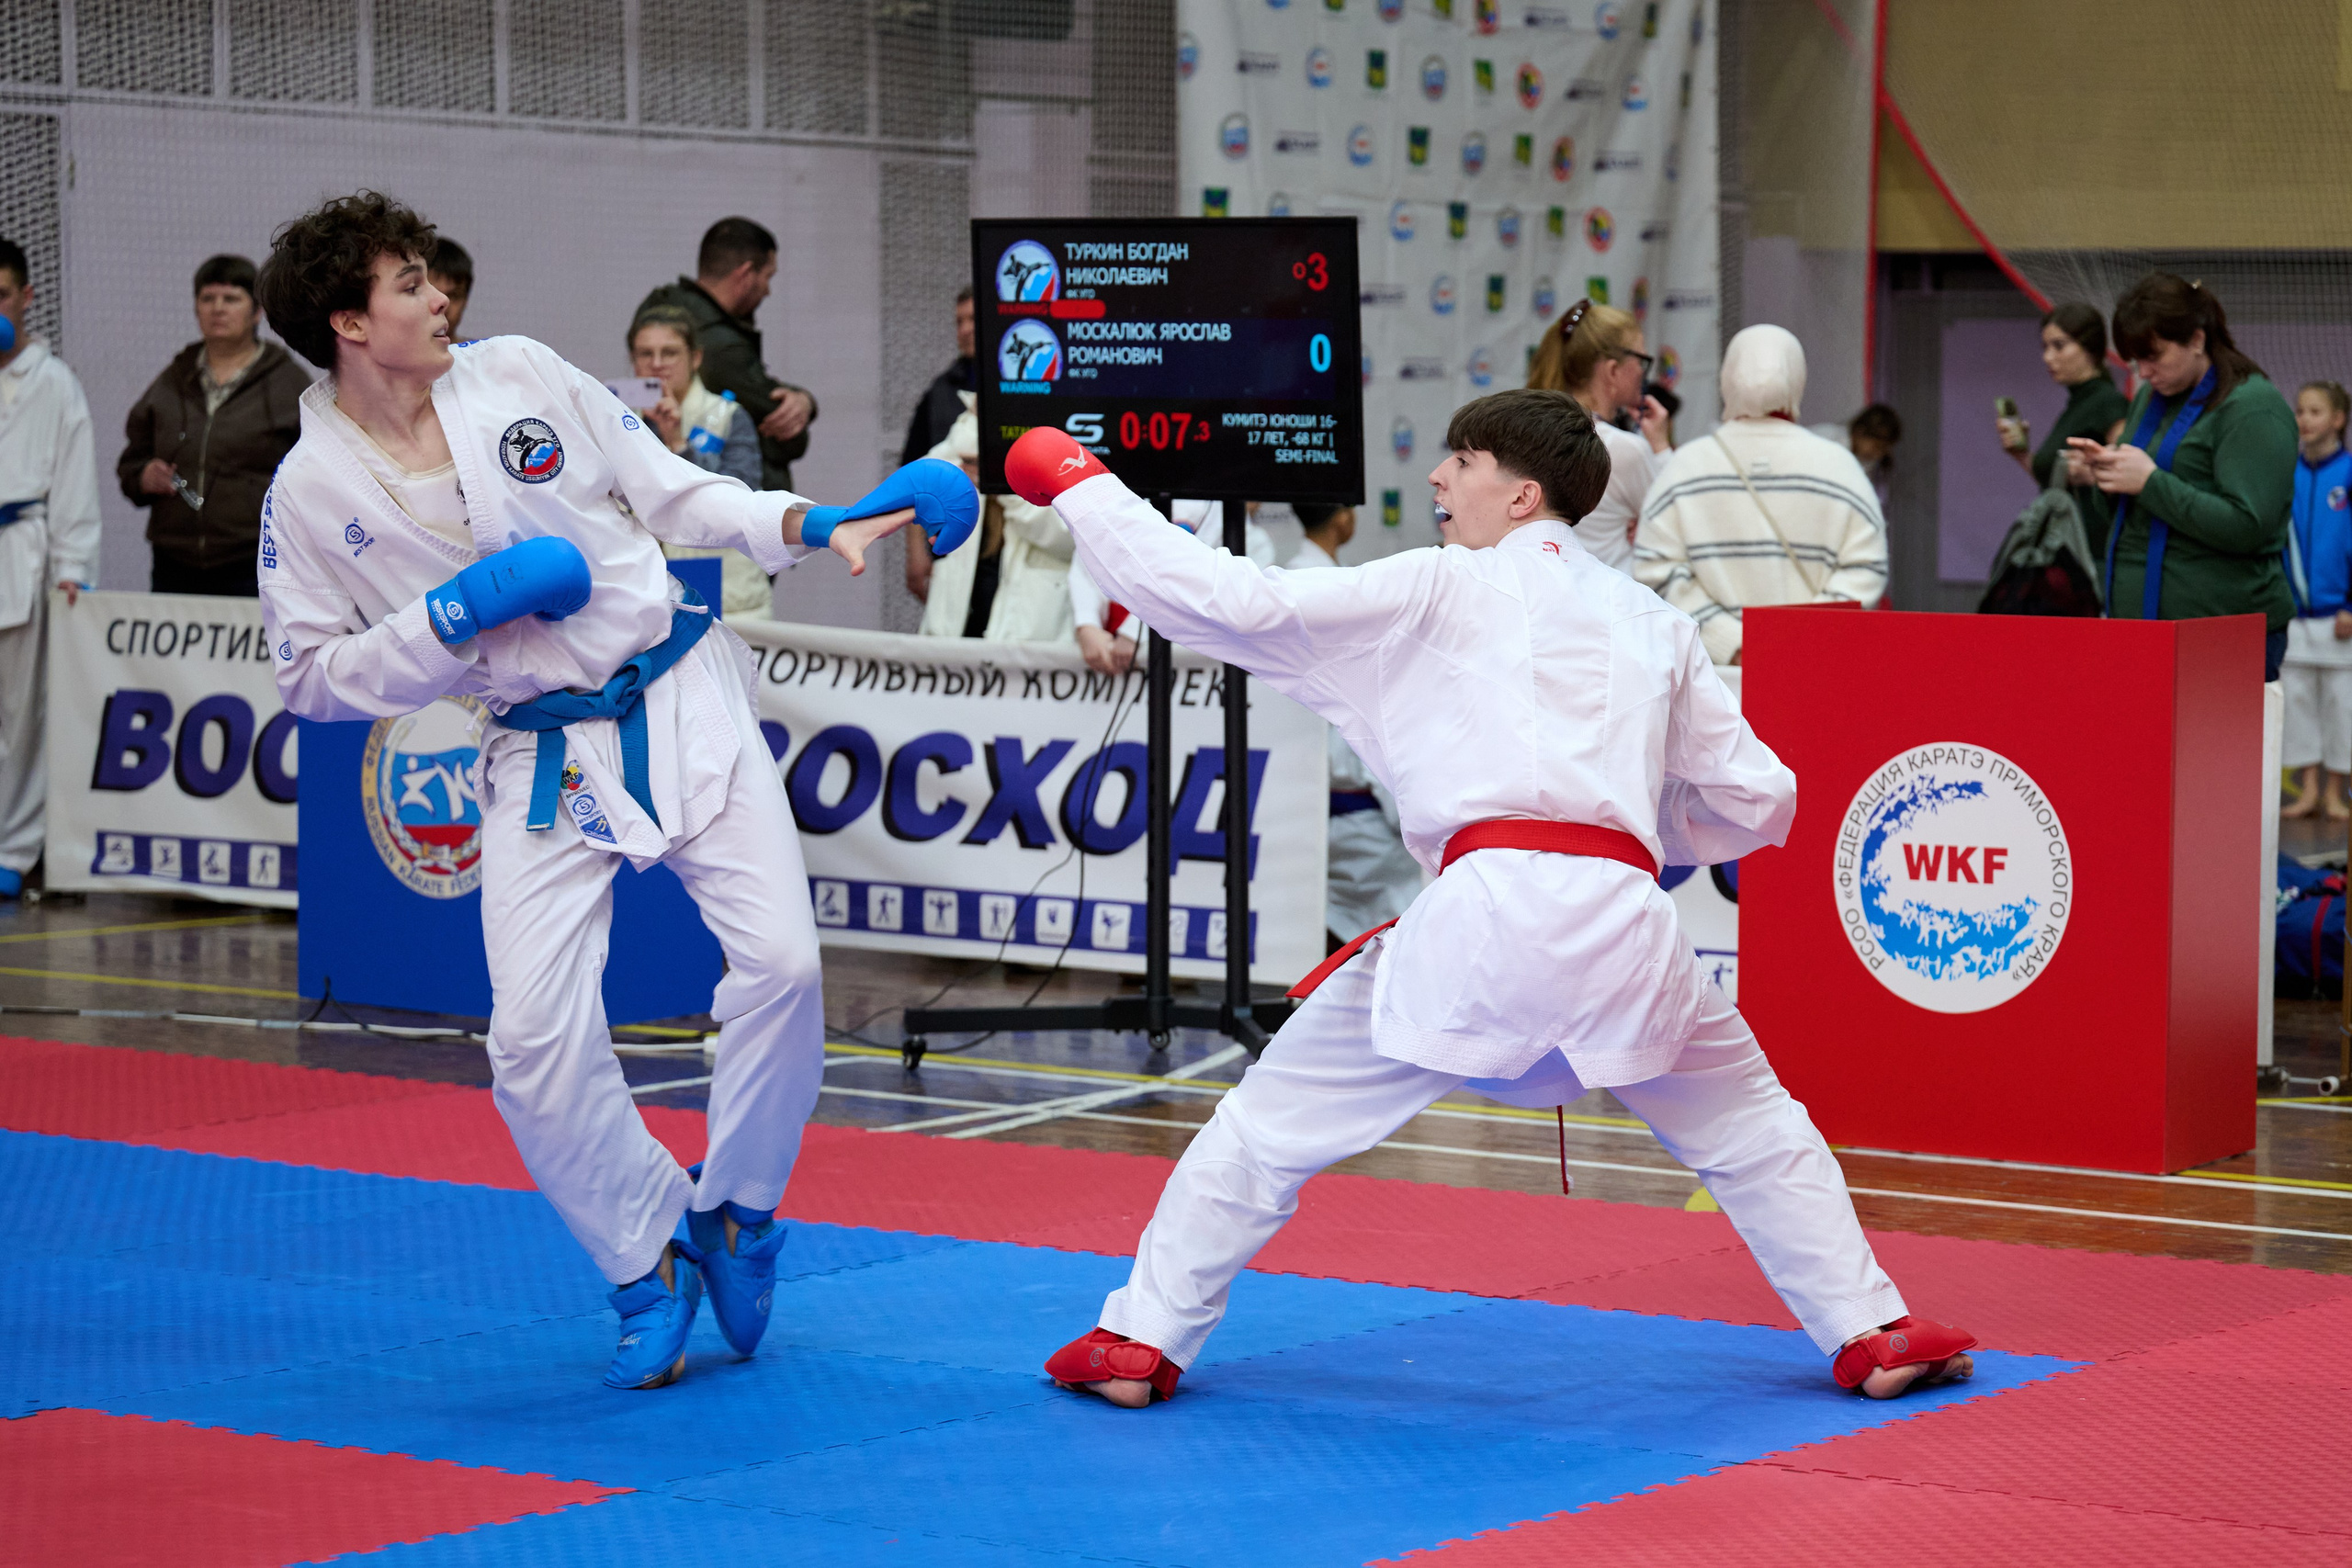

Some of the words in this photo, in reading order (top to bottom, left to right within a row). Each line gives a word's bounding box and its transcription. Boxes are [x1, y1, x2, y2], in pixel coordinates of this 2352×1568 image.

[1065, 243, 1124, 261] ТУРКИН
[1127, 243, 1189, 264] БОГДАН
[1066, 266, 1169, 286] НИКОЛАЕВИЧ
[1306, 252, 1329, 291] 3
[1067, 322, 1156, 341] МОСКАЛЮК
[1159, 323, 1232, 341] ЯРОСЛАВ
[1069, 346, 1162, 366] РОМАНОВИЧ
[1309, 333, 1332, 373] 0
[999, 381, 1051, 394] WARNING
[1222, 412, 1268, 428] КУМИТЭ
[1269, 413, 1317, 428] ЮНОШИ
[1248, 431, 1261, 446] 17
[1311, 432, 1327, 446] КГ
[1274, 448, 1340, 464] SEMI-FINAL
[263, 519, 277, 570] BEST
[353, 546, 364, 558] BEST
[1022, 667, 1252, 709] КОМПЕК
[1905, 747, 1984, 774] КАРАТЭ
[562, 773, 579, 784] WKF
[1838, 761, 1905, 900] «ФЕДЕРАЦИЯ
[1989, 758, 2069, 919] ПРИМОРСКОГО
[1903, 842, 2008, 886] WKF
[1845, 908, 1885, 971] РСОО
[2012, 923, 2060, 982] КРАЯ»
